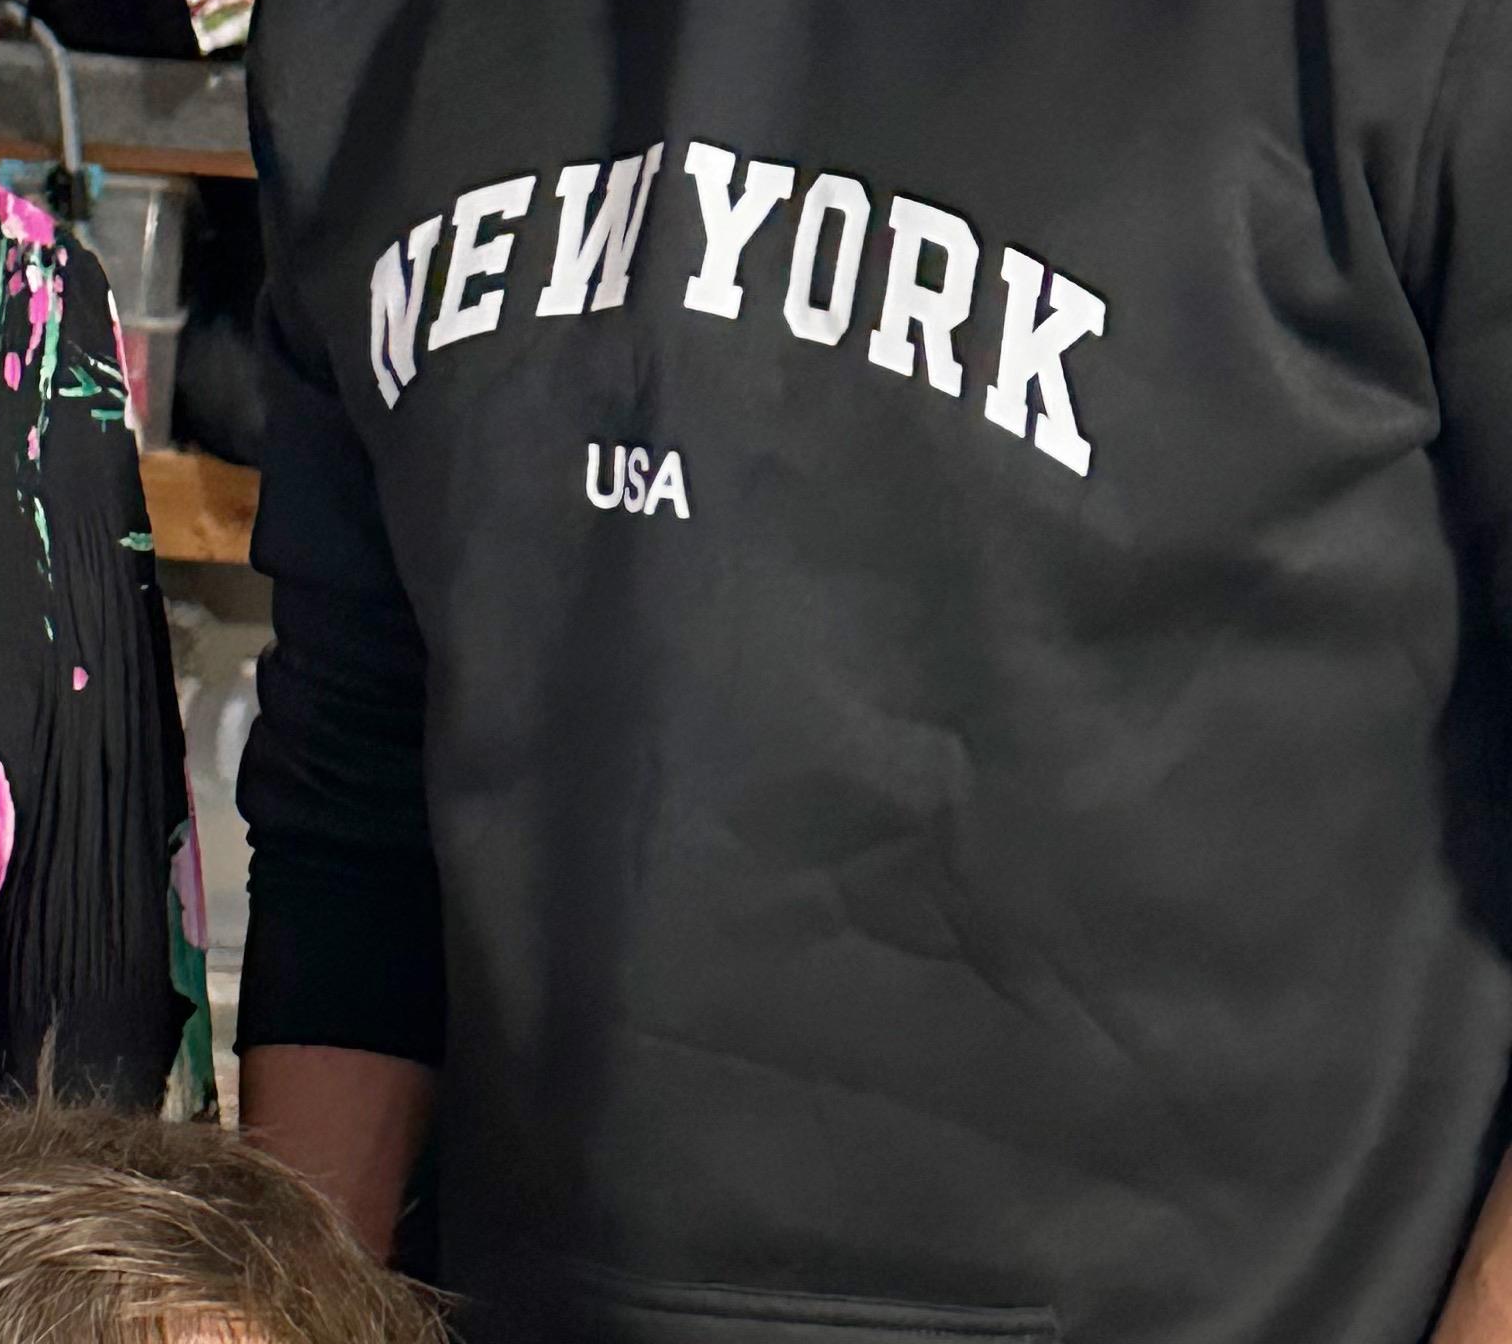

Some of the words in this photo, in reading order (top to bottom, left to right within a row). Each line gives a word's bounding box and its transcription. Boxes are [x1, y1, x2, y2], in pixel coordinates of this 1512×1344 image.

[371, 142, 665, 409] NEW
[683, 141, 1107, 477] YORK
[586, 443, 690, 519] USA
